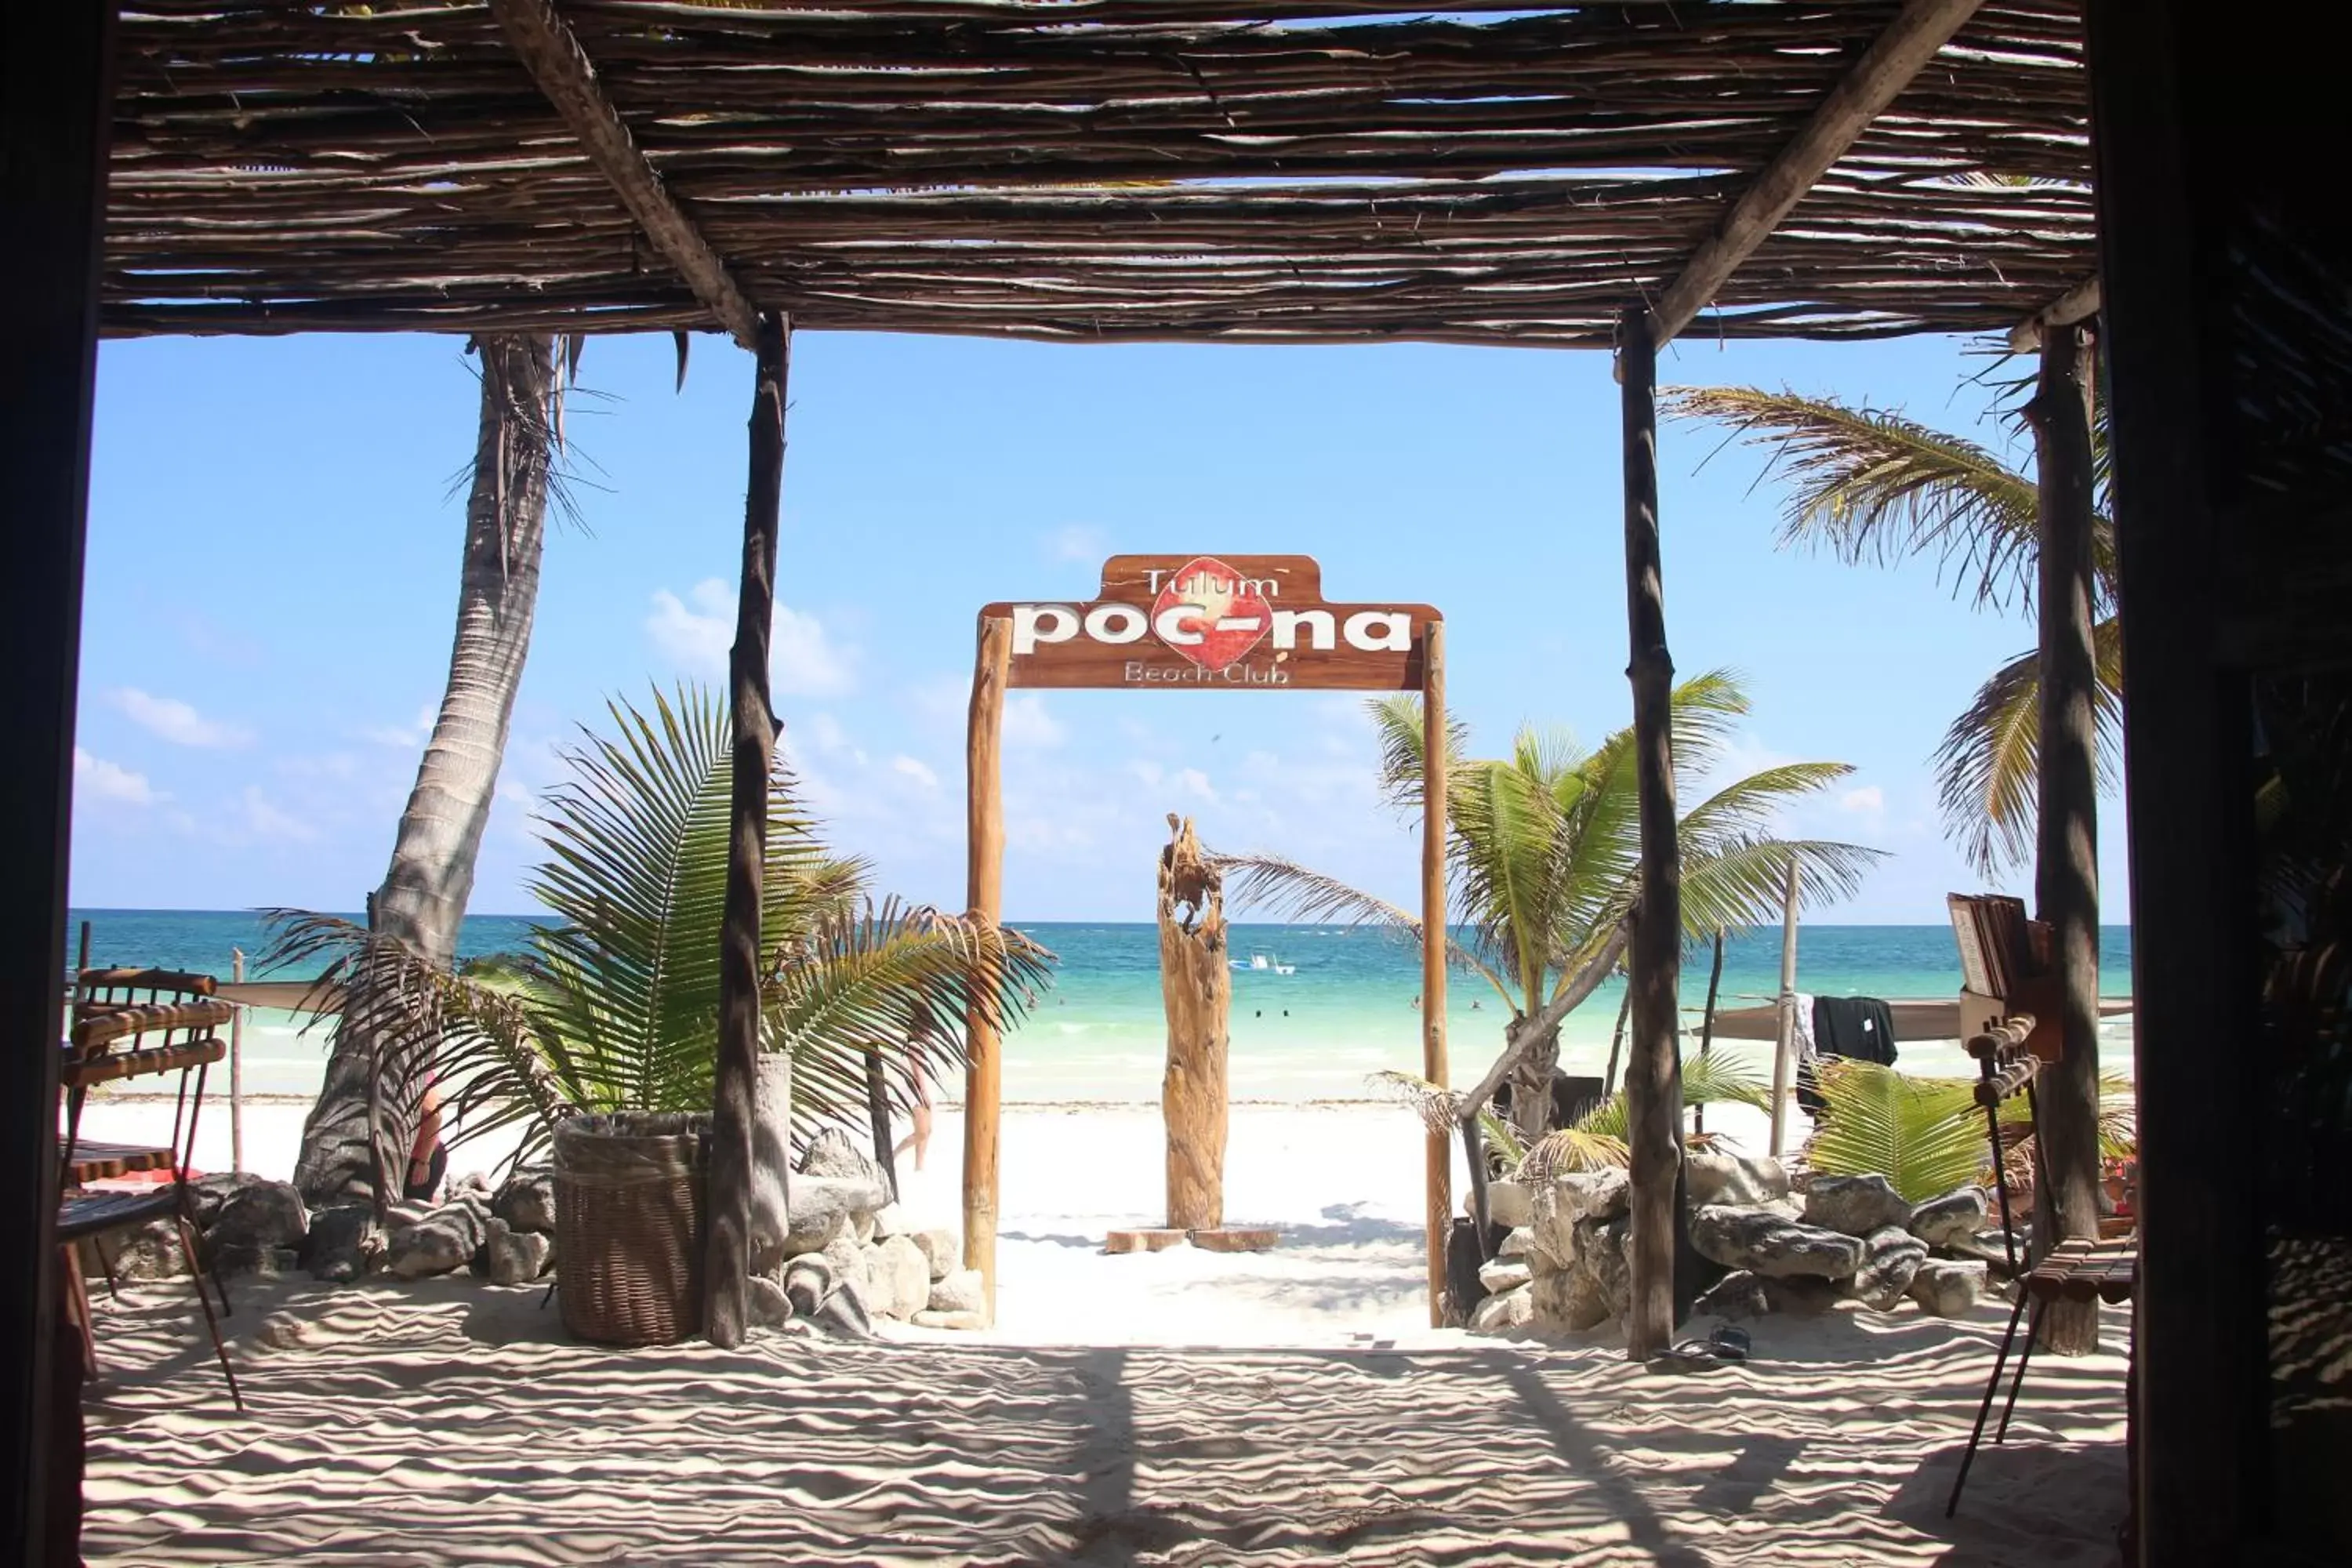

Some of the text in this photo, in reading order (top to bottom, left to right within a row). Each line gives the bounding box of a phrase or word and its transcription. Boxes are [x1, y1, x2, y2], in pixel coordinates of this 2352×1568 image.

[1142, 567, 1279, 597] Tulum
[1012, 603, 1411, 655] poc-na
[1124, 661, 1289, 685] Beach Club
